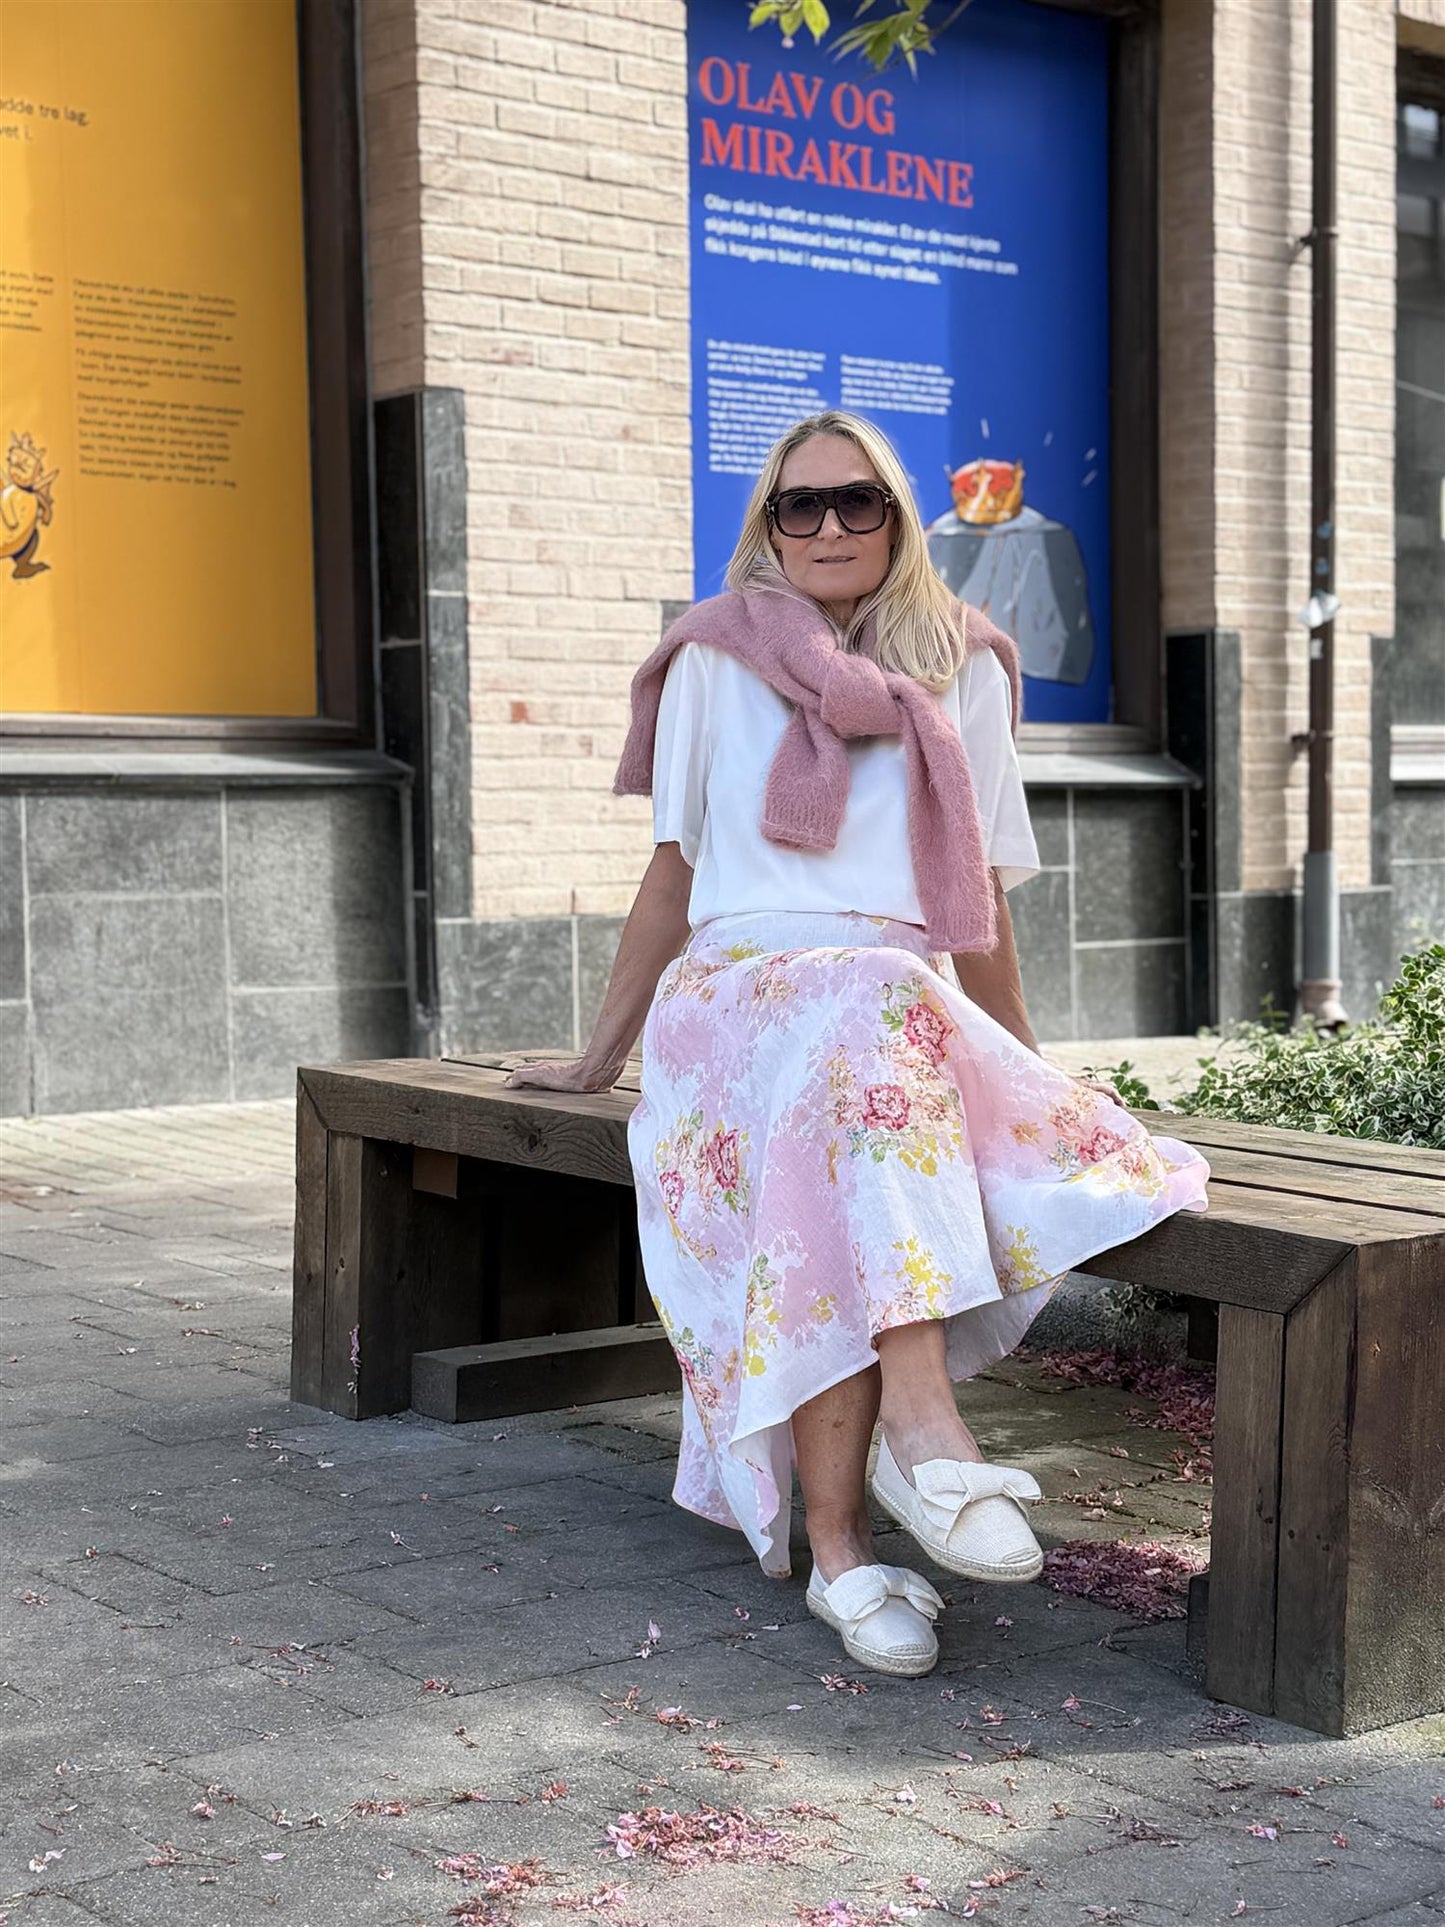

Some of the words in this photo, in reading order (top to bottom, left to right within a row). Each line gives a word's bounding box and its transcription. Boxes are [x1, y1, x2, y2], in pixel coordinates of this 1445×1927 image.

[699, 57, 824, 120] OLAV
[831, 83, 895, 135] OG
[701, 118, 974, 209] MIRAKLENE
[704, 193, 732, 213] Olav
[732, 199, 757, 217] skal
